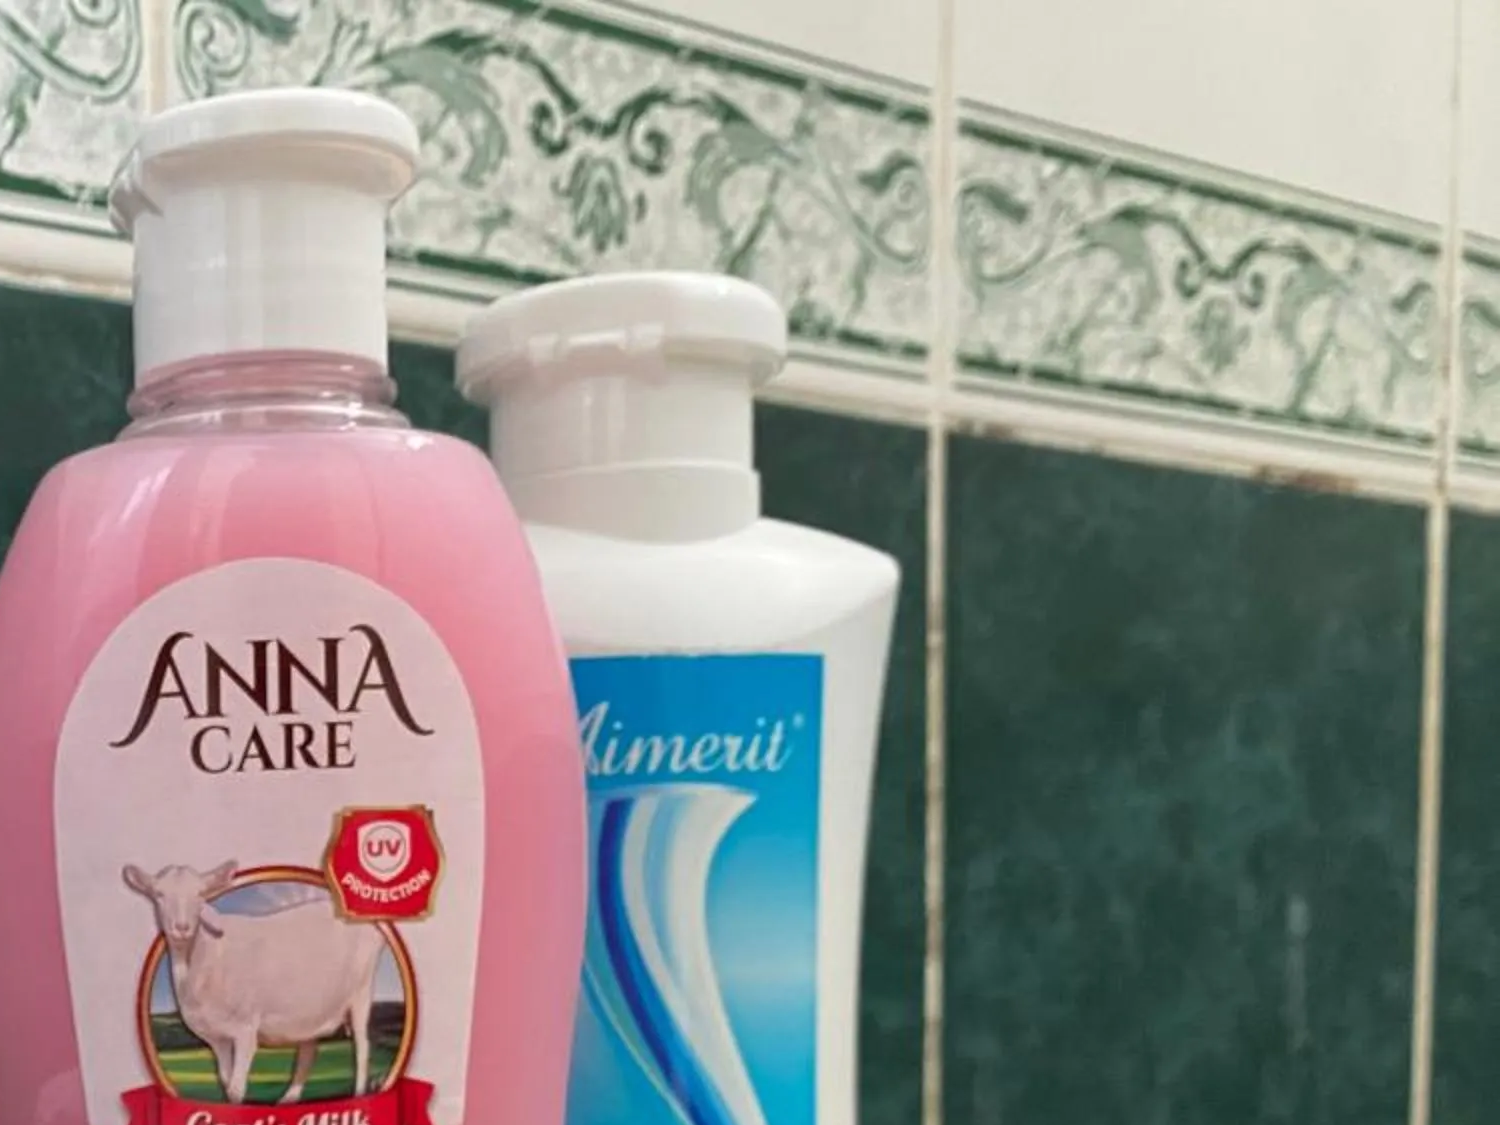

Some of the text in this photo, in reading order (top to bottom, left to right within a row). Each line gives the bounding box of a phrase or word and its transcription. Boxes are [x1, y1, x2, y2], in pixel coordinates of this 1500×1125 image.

[109, 624, 434, 748] ANNA
[190, 720, 357, 774] CARE
[367, 839, 401, 857] UV
[341, 868, 431, 903] PROTECTION
